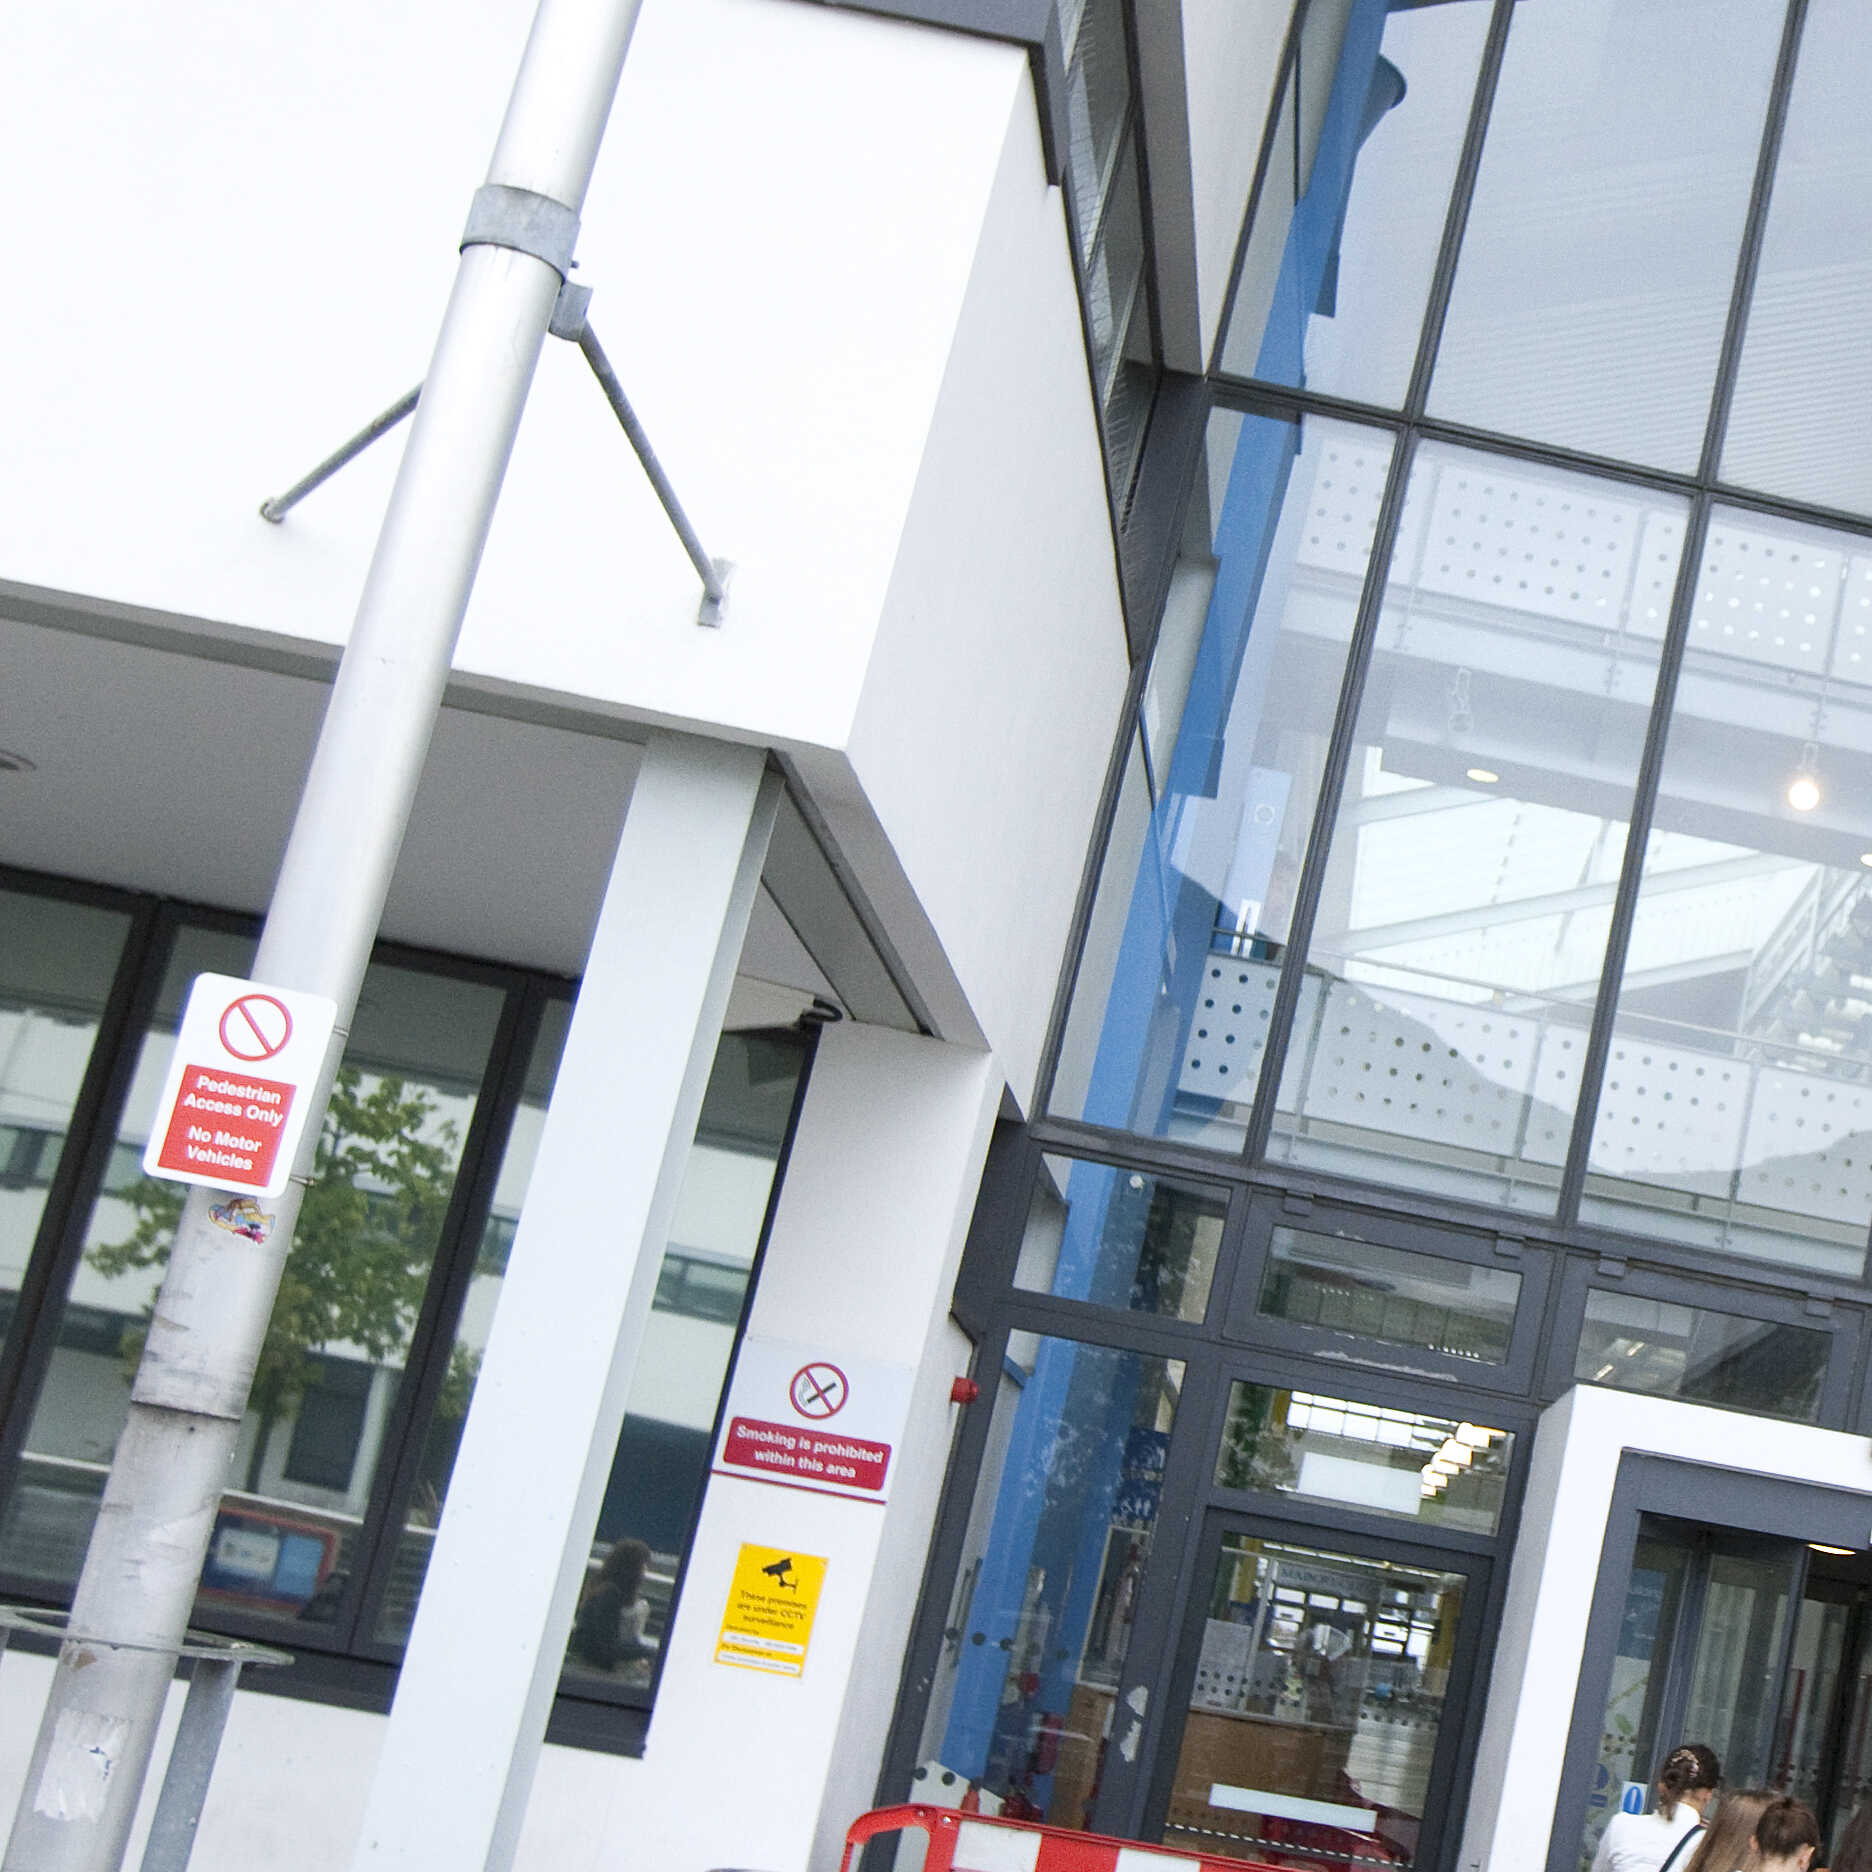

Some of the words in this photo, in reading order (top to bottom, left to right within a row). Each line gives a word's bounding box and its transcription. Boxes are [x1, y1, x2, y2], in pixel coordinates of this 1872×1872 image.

[197, 1075, 281, 1105] Pedestrian
[184, 1092, 242, 1117] Access
[246, 1104, 283, 1128] Only
[187, 1125, 211, 1143] No
[214, 1130, 262, 1152] Motor
[187, 1144, 253, 1171] Vehicles
[736, 1425, 796, 1450] Smoking
[799, 1436, 811, 1450] is
[813, 1439, 884, 1464] prohibited
[754, 1450, 794, 1468] within
[798, 1456, 823, 1473] this
[826, 1463, 856, 1478] area
